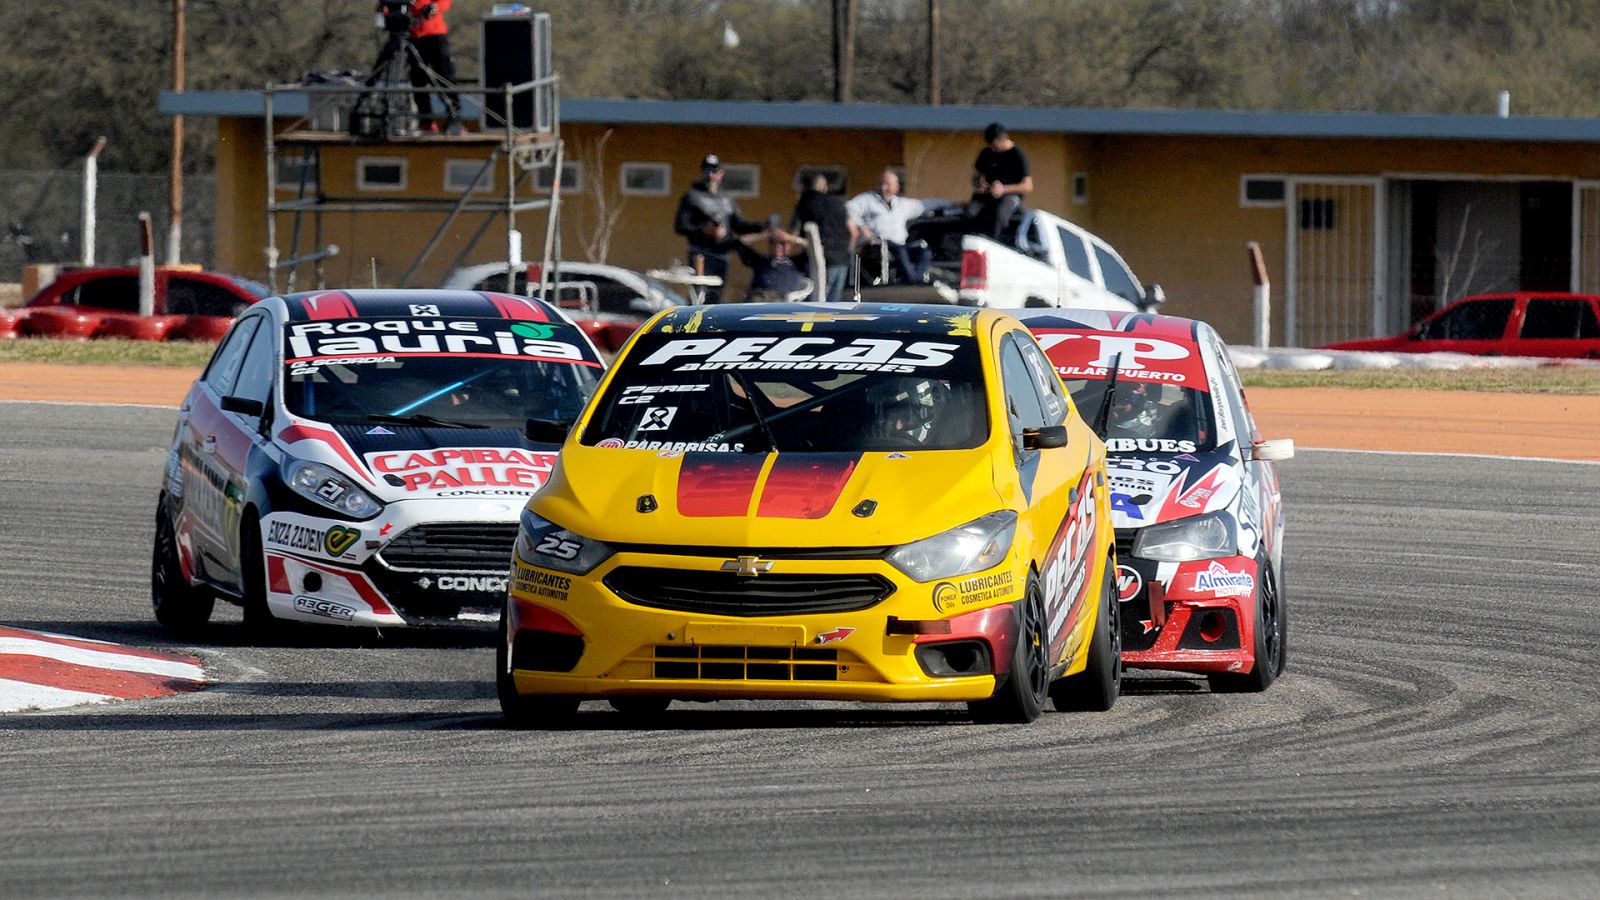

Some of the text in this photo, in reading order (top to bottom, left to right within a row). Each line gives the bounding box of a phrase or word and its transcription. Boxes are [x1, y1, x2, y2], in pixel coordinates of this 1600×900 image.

[639, 337, 960, 367] PECAS
[290, 367, 320, 375] C2
[673, 361, 917, 373] AUTOMOTORES
[1116, 369, 1186, 381] PUERTO
[622, 384, 711, 394] PEREZ
[618, 395, 655, 404] C2
[318, 481, 345, 500] 21
[268, 520, 324, 552] ENZA ZADEN
[535, 536, 581, 559] 25
[517, 568, 571, 590] LUBRICANTES
[959, 571, 1013, 593] LUBRICANTES
[961, 591, 992, 605] COSMETICA
